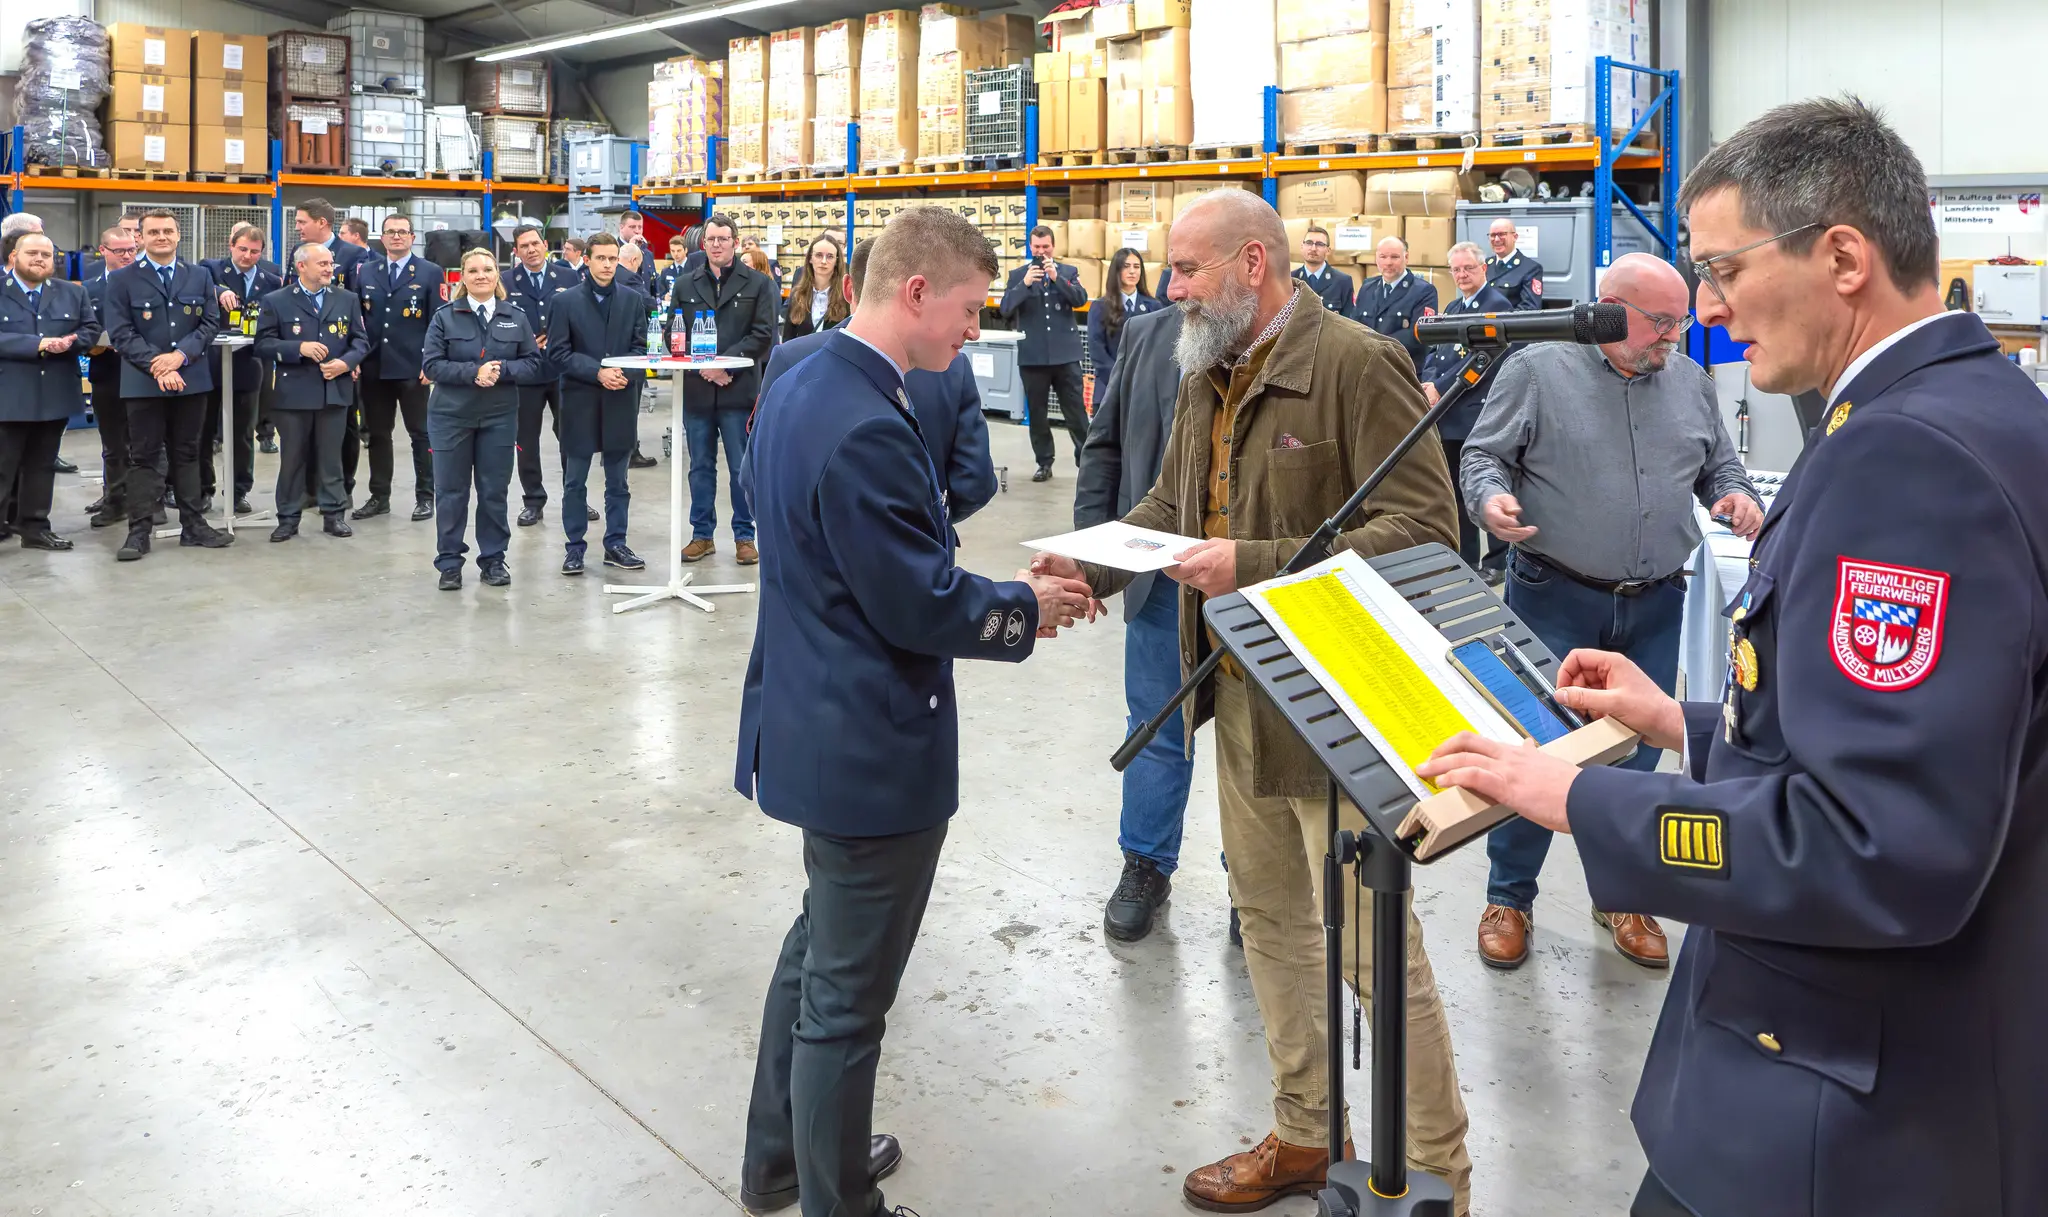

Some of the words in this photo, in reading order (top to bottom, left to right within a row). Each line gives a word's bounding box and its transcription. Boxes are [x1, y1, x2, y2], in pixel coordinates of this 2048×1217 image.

[1958, 193, 1993, 202] Auftrag
[1995, 193, 2012, 201] des
[1944, 216, 1993, 224] Miltenberg
[1848, 569, 1936, 594] FREIWILLIGE
[1850, 581, 1932, 606] FEUERWEHR
[1835, 612, 1870, 678] LANDKREIS
[1873, 627, 1932, 683] MILTENBERG
